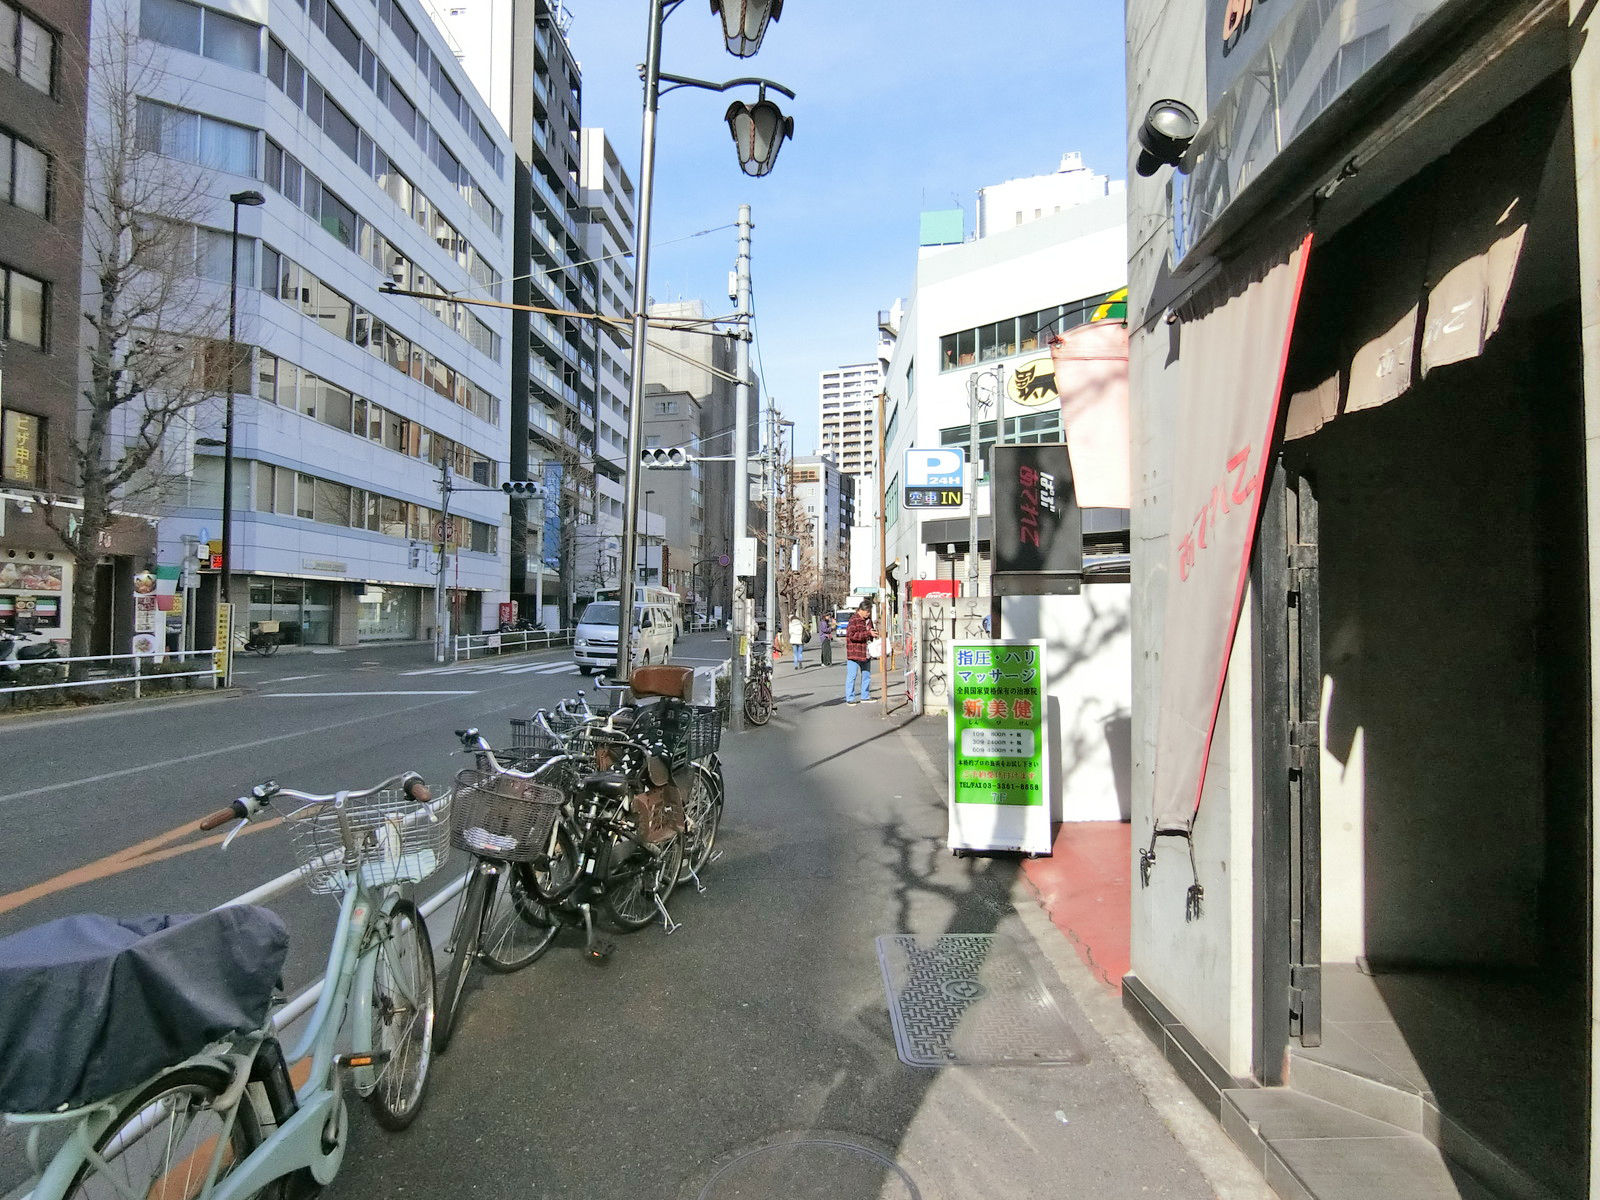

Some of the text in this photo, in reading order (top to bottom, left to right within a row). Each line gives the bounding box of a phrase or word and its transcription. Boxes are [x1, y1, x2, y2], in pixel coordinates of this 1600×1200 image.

[907, 451, 961, 485] P
[929, 476, 961, 485] 24H
[908, 490, 961, 506] 空車 IN
[957, 649, 1036, 667] 指圧・ハリ
[957, 668, 1037, 684] マッサージ
